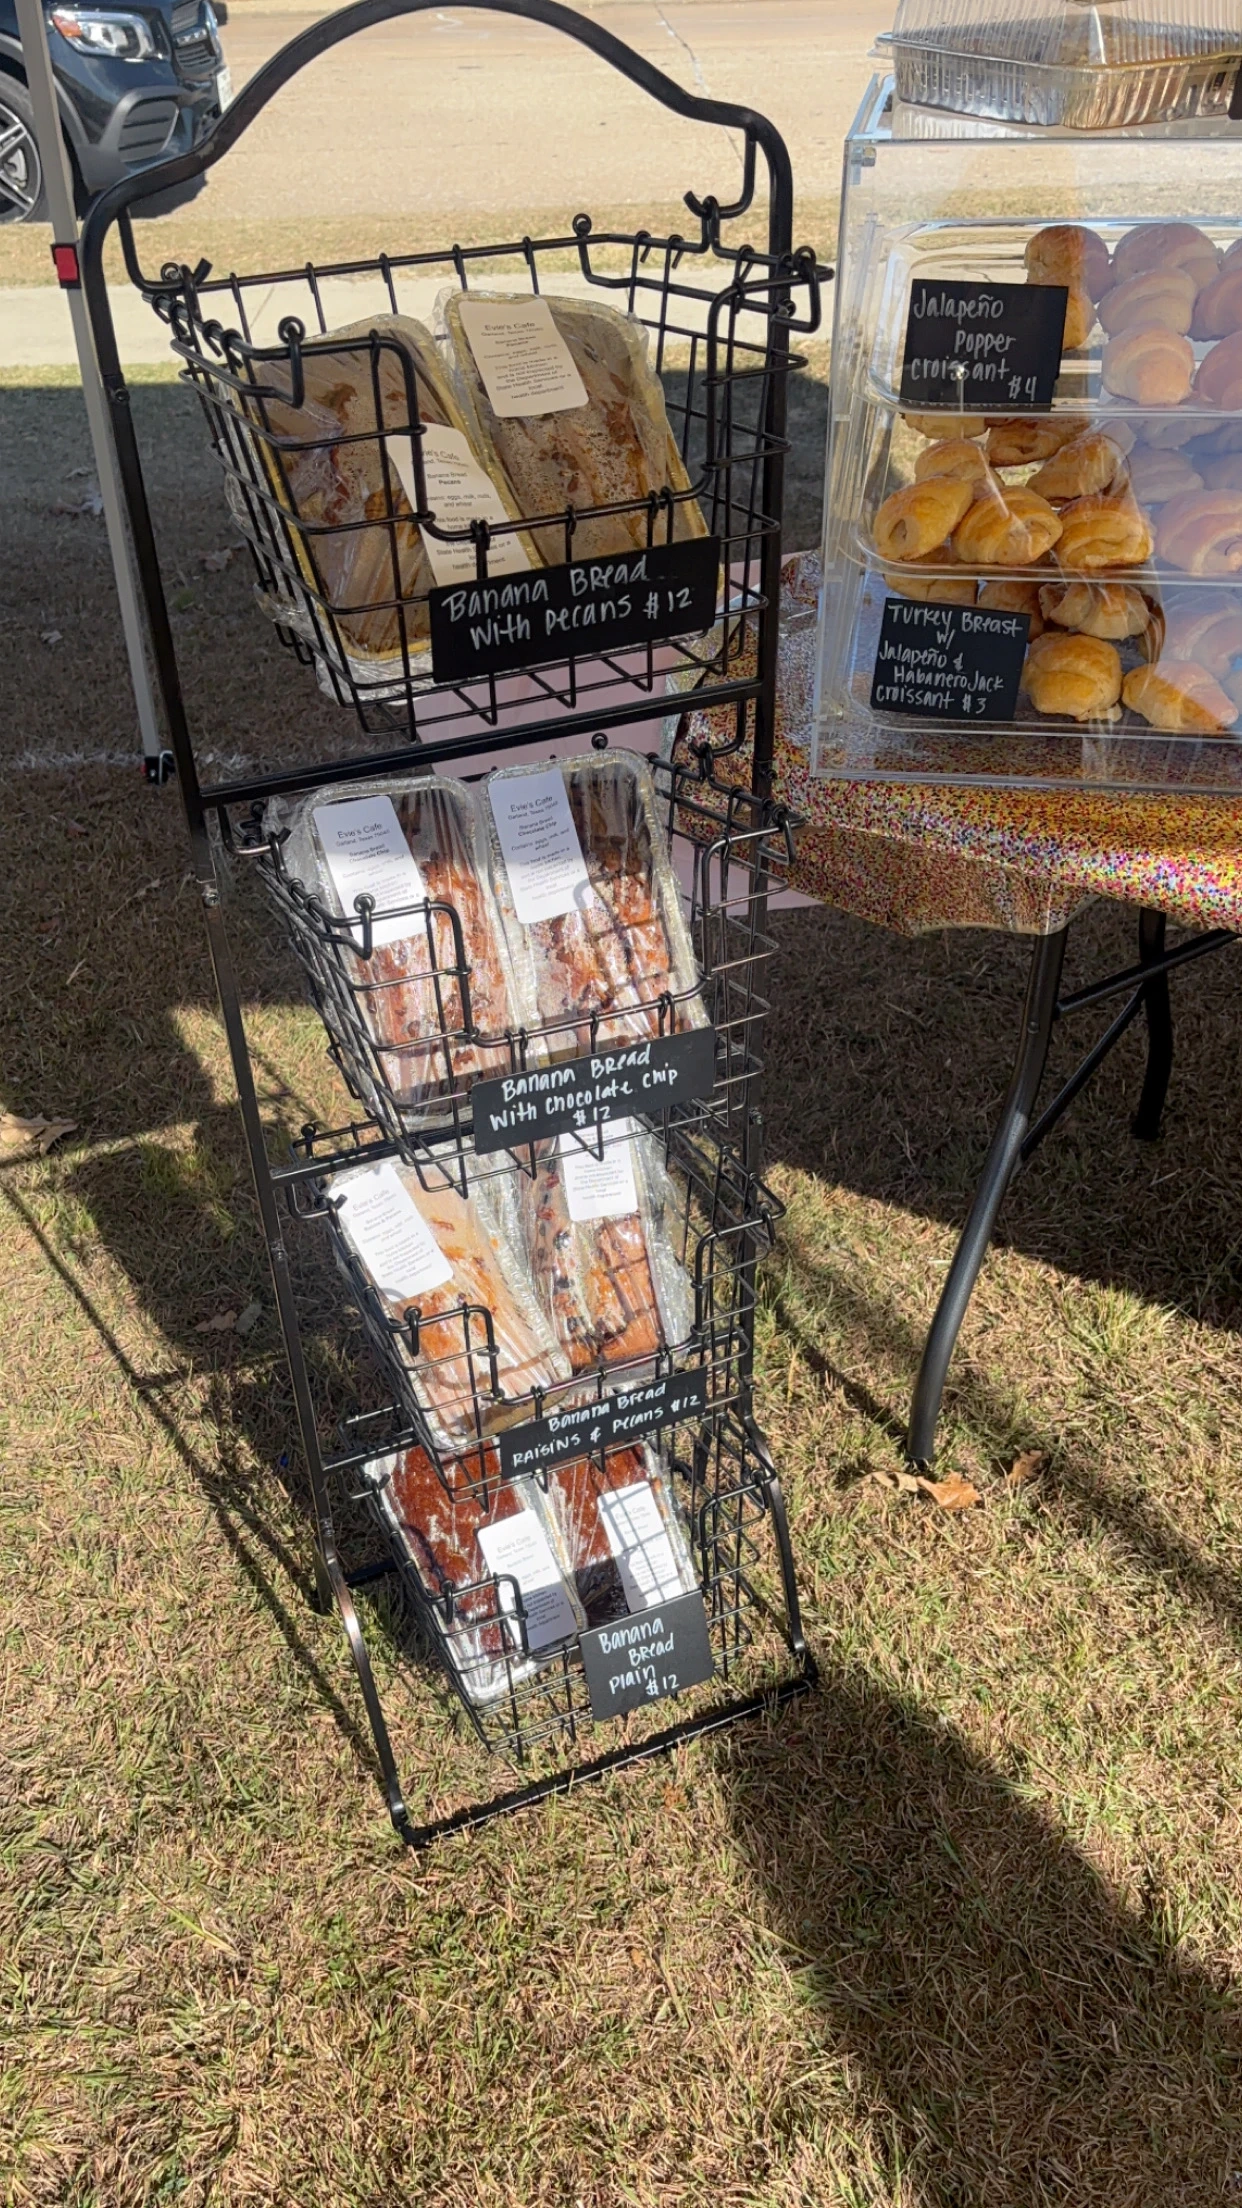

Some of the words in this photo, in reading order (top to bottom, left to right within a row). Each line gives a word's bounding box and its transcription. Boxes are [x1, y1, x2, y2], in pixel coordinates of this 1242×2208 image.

[914, 288, 1004, 325] Jalapeño
[1008, 375, 1037, 401] $4
[441, 579, 549, 622] Banana
[470, 613, 531, 651] With
[642, 587, 693, 619] $12
[879, 640, 947, 668] Jalapeño
[962, 693, 987, 714] $3
[501, 1067, 576, 1102] Banana
[490, 1102, 537, 1132] With
[572, 1106, 611, 1127] $12
[548, 1402, 610, 1433] Banana
[616, 1382, 667, 1410] Bread
[670, 1394, 701, 1413] $12
[598, 1617, 664, 1654] Banana
[646, 1674, 680, 1695] $12
